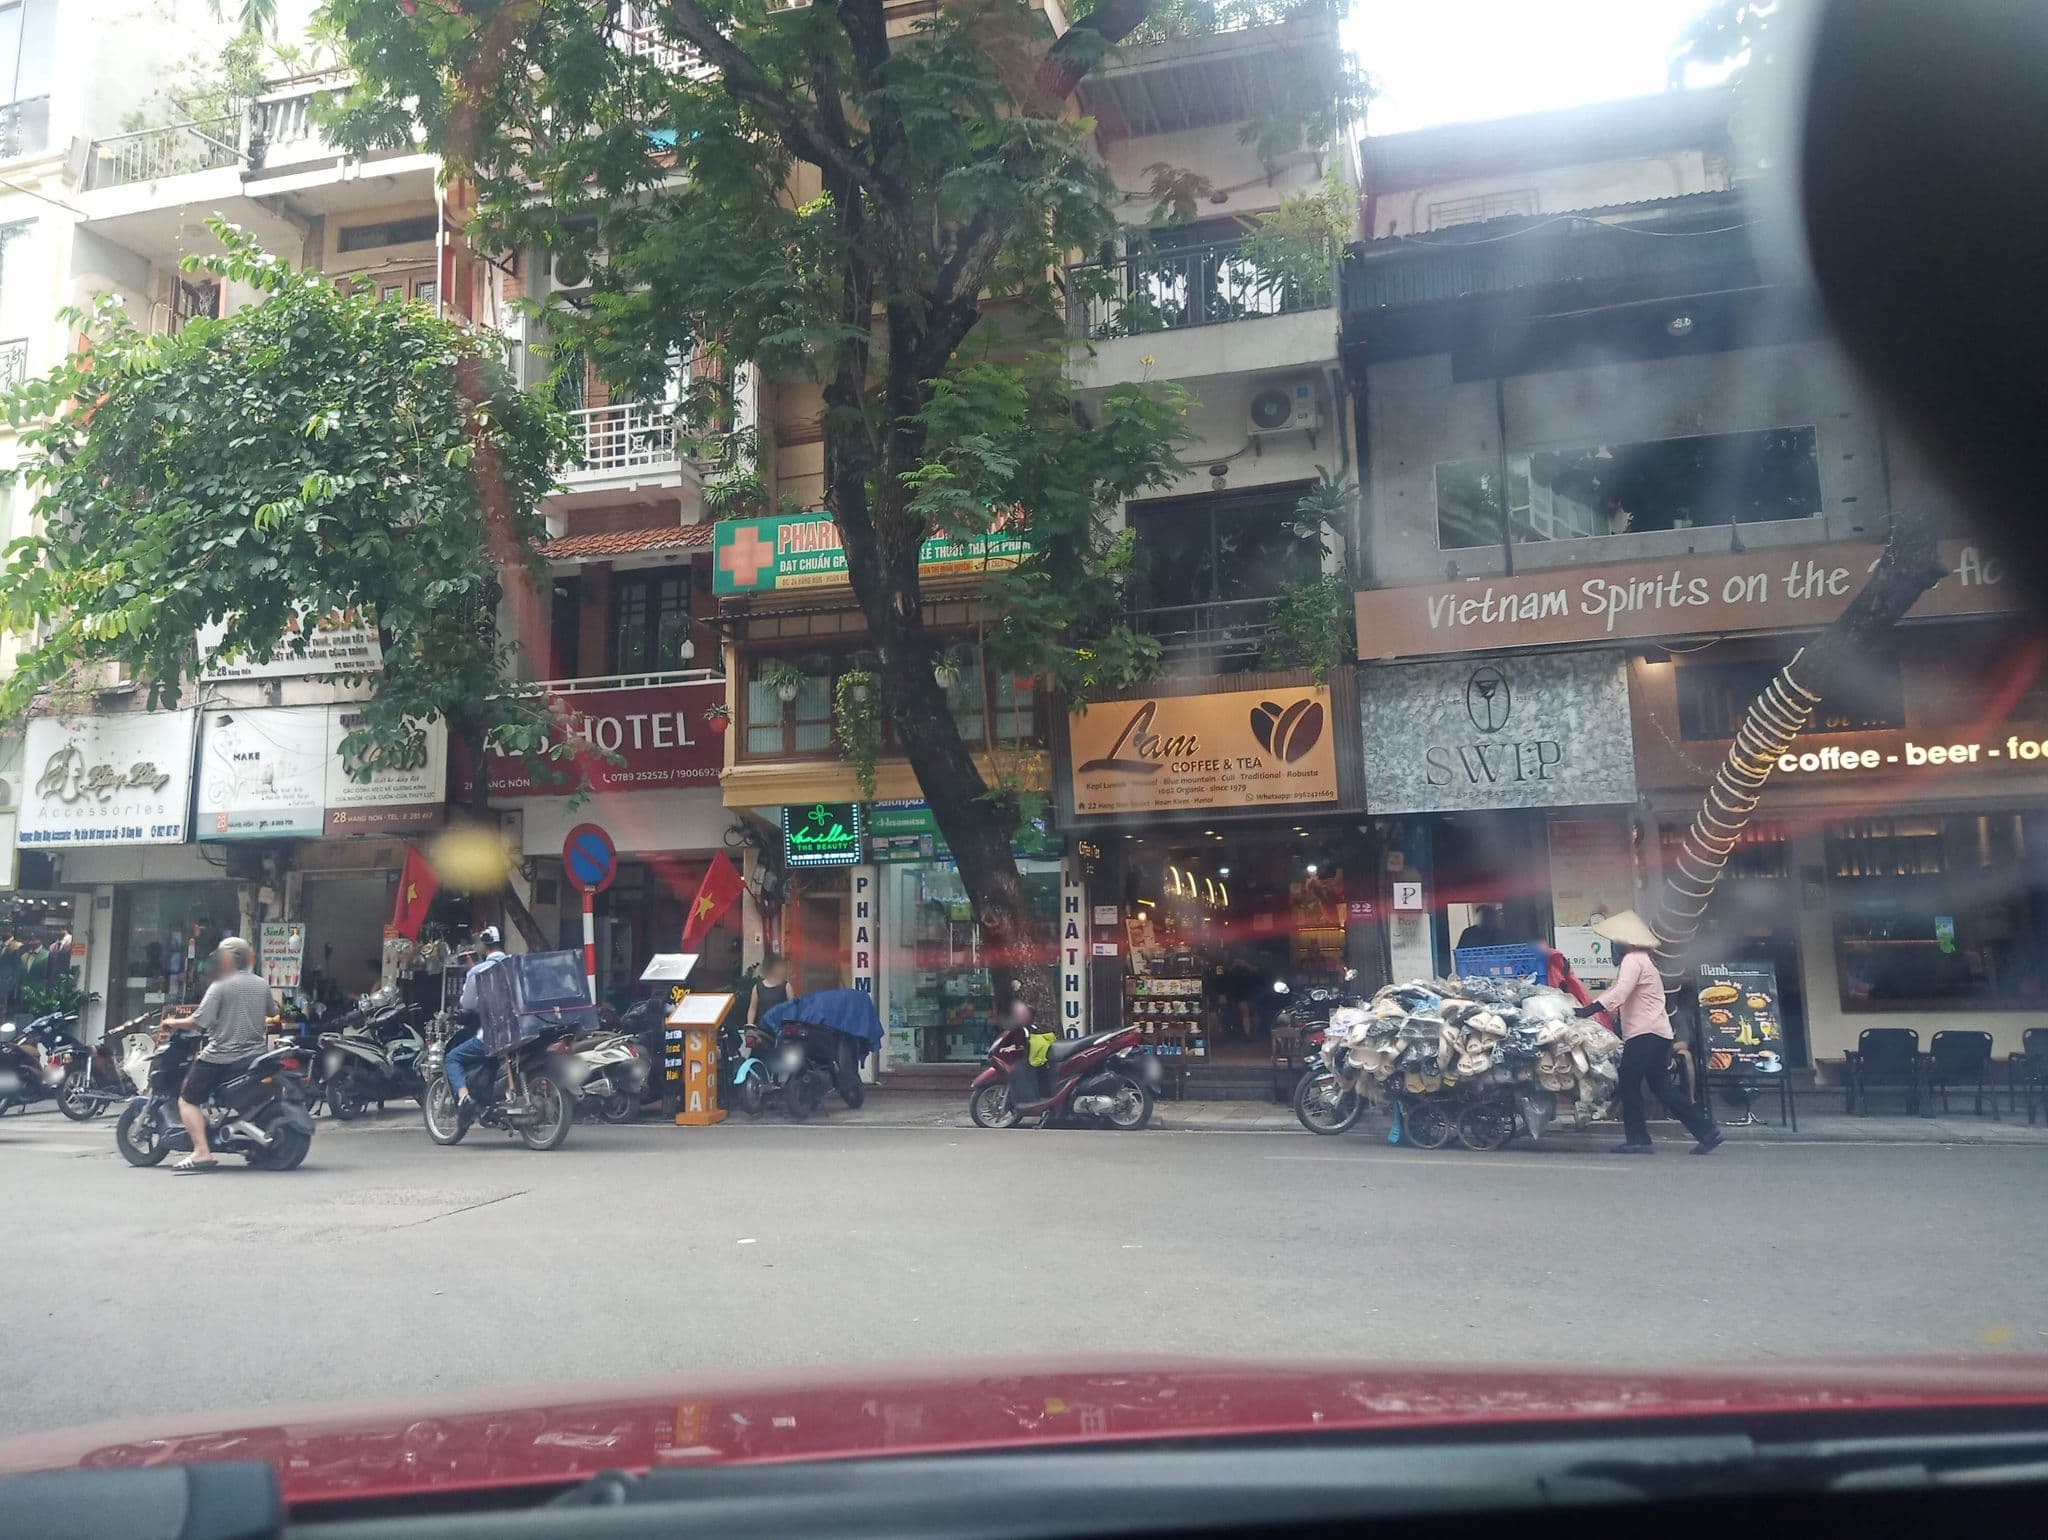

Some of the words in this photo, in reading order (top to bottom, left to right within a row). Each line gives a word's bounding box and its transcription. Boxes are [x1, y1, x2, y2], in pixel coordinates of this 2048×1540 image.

[780, 560, 797, 574] ĐẠT
[1428, 587, 1569, 629] Vietnam
[1580, 570, 1710, 632] Spirits
[1722, 573, 1767, 603] on
[1781, 560, 1850, 600] the
[217, 666, 227, 676] 28
[566, 711, 696, 751] HOTEL
[233, 752, 260, 761] MAKE
[1777, 746, 1880, 772] coffee
[1905, 742, 1980, 766] beer
[1171, 759, 1220, 773] COFFEE
[1223, 759, 1232, 769] &
[1237, 757, 1262, 770] TEA
[611, 773, 634, 782] 0789
[637, 772, 668, 780] 252525
[1240, 771, 1281, 780] Traditional
[1287, 770, 1319, 778] Robusta
[1176, 786, 1205, 795] Organic
[1230, 784, 1247, 792] 1979
[38, 804, 165, 819] Accessories
[333, 812, 347, 823] 28
[817, 842, 848, 850] BEAUTY
[1351, 902, 1372, 913] 22
[707, 1031, 717, 1110] OOT
